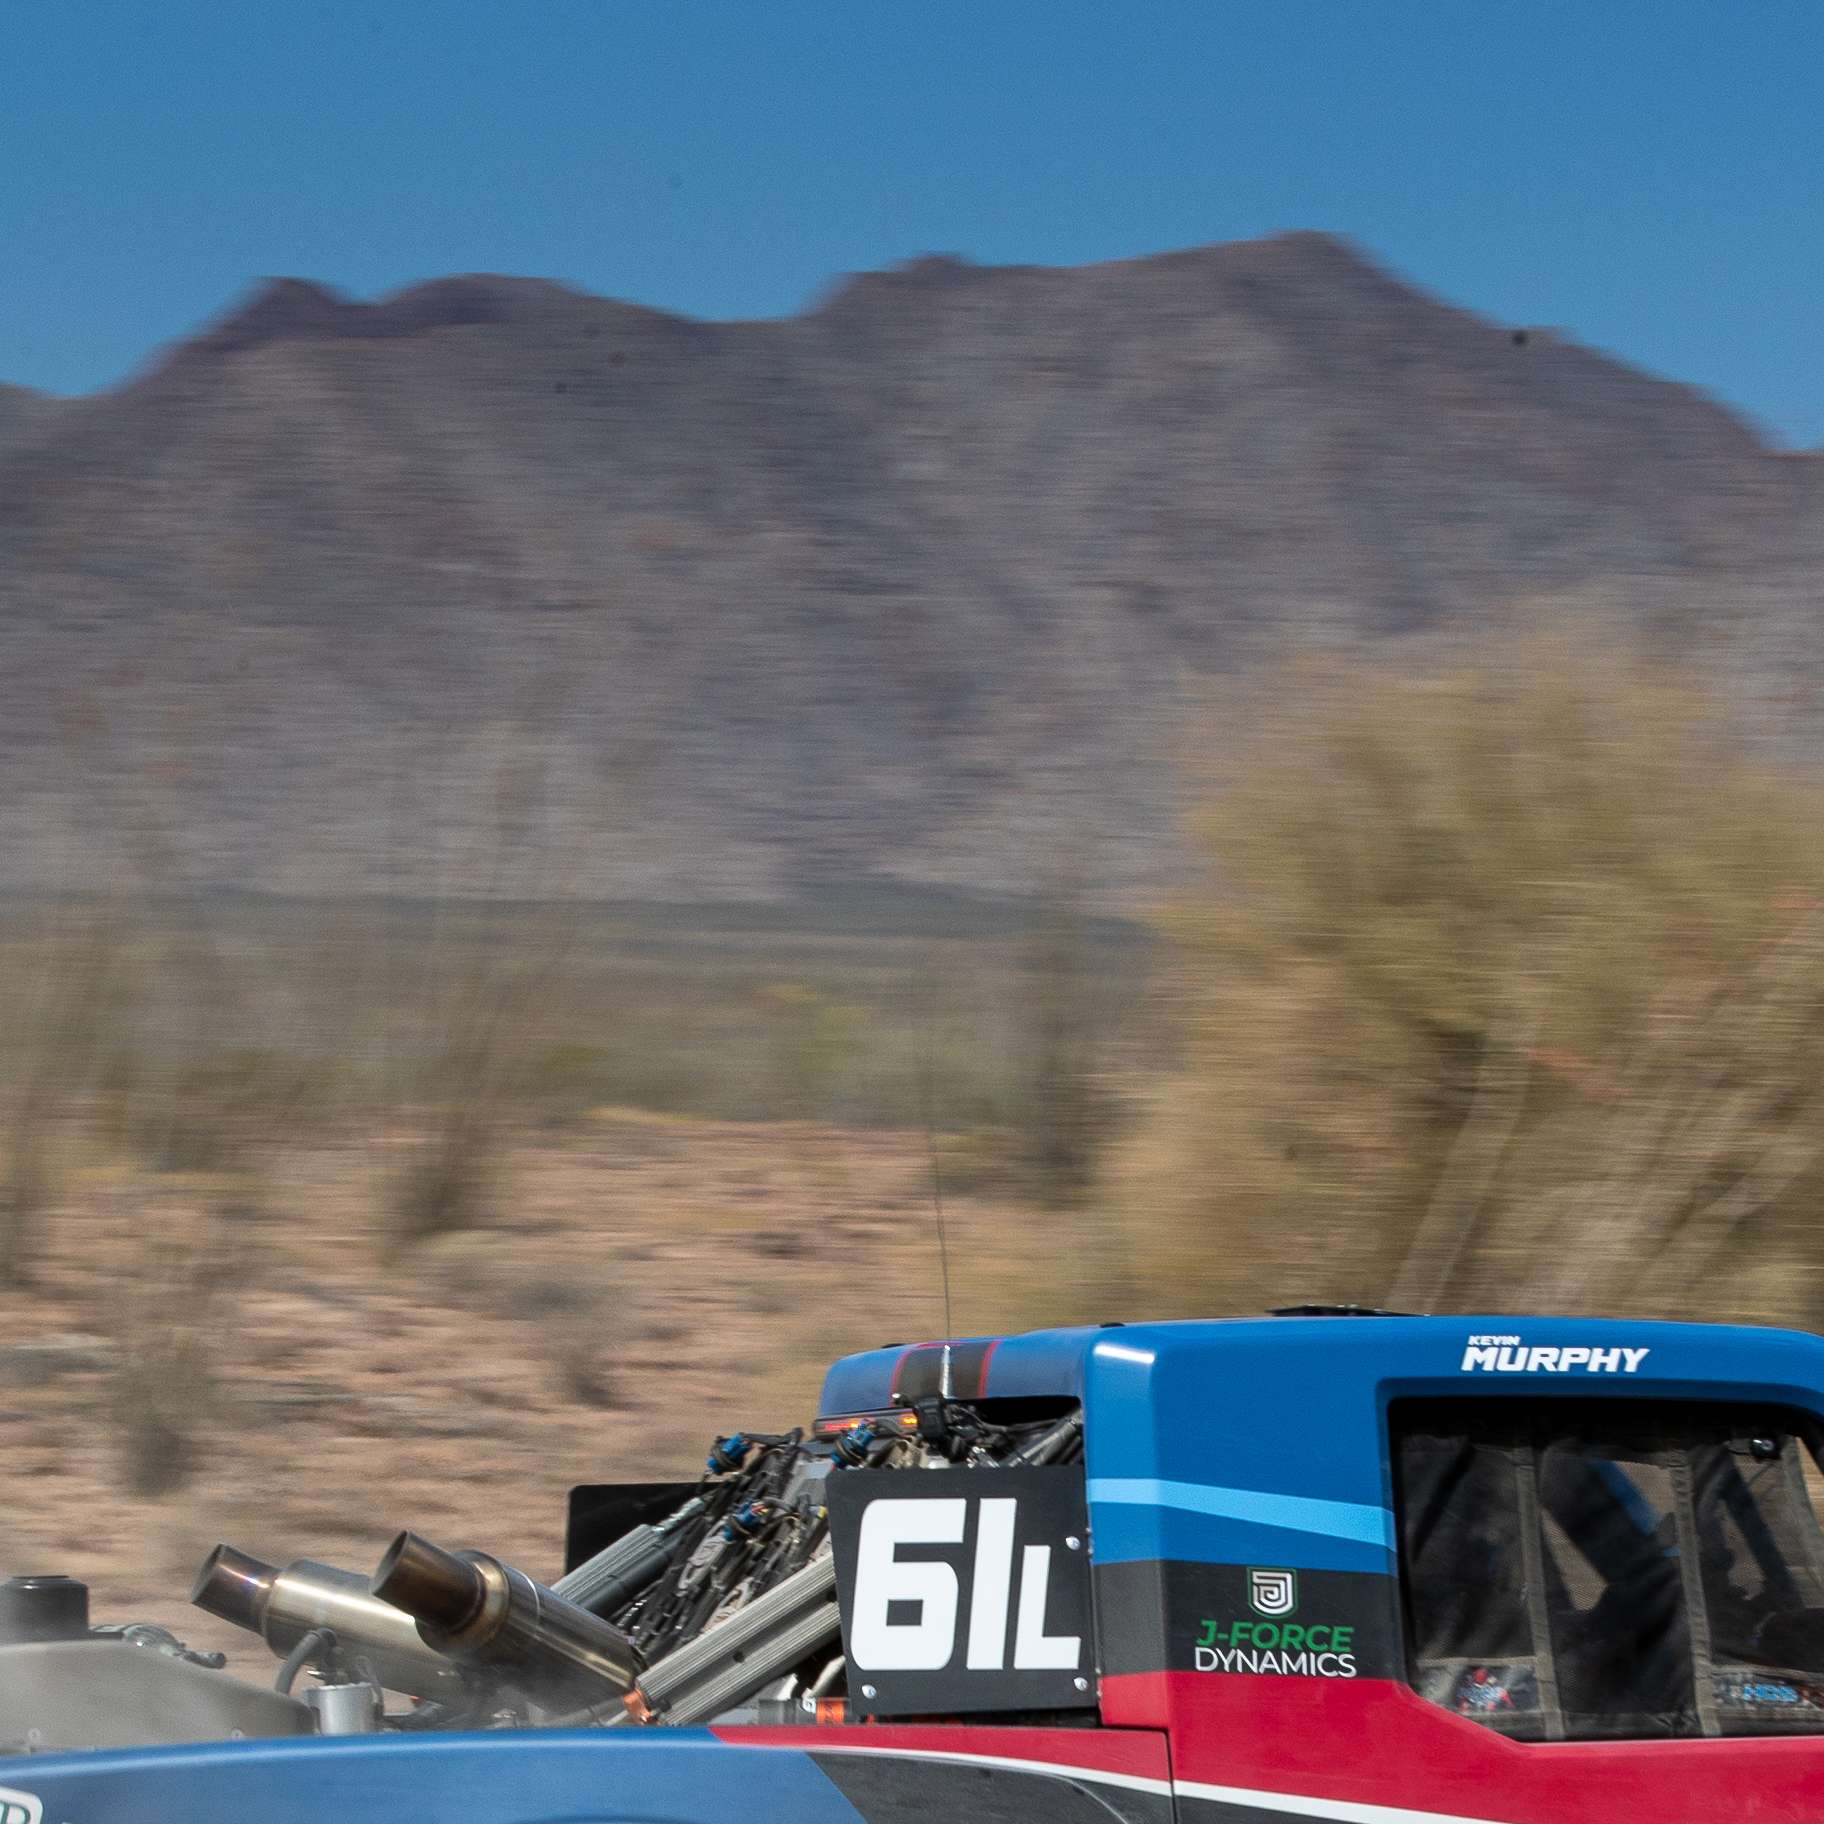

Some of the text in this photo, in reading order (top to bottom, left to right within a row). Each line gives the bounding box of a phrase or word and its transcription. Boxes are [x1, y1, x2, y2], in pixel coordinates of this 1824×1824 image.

[1468, 1335, 1521, 1346] KEVIN
[1461, 1346, 1651, 1373] MURPHY
[1196, 1619, 1354, 1652] J-FORCE
[1195, 1646, 1357, 1678] DYNAMICS
